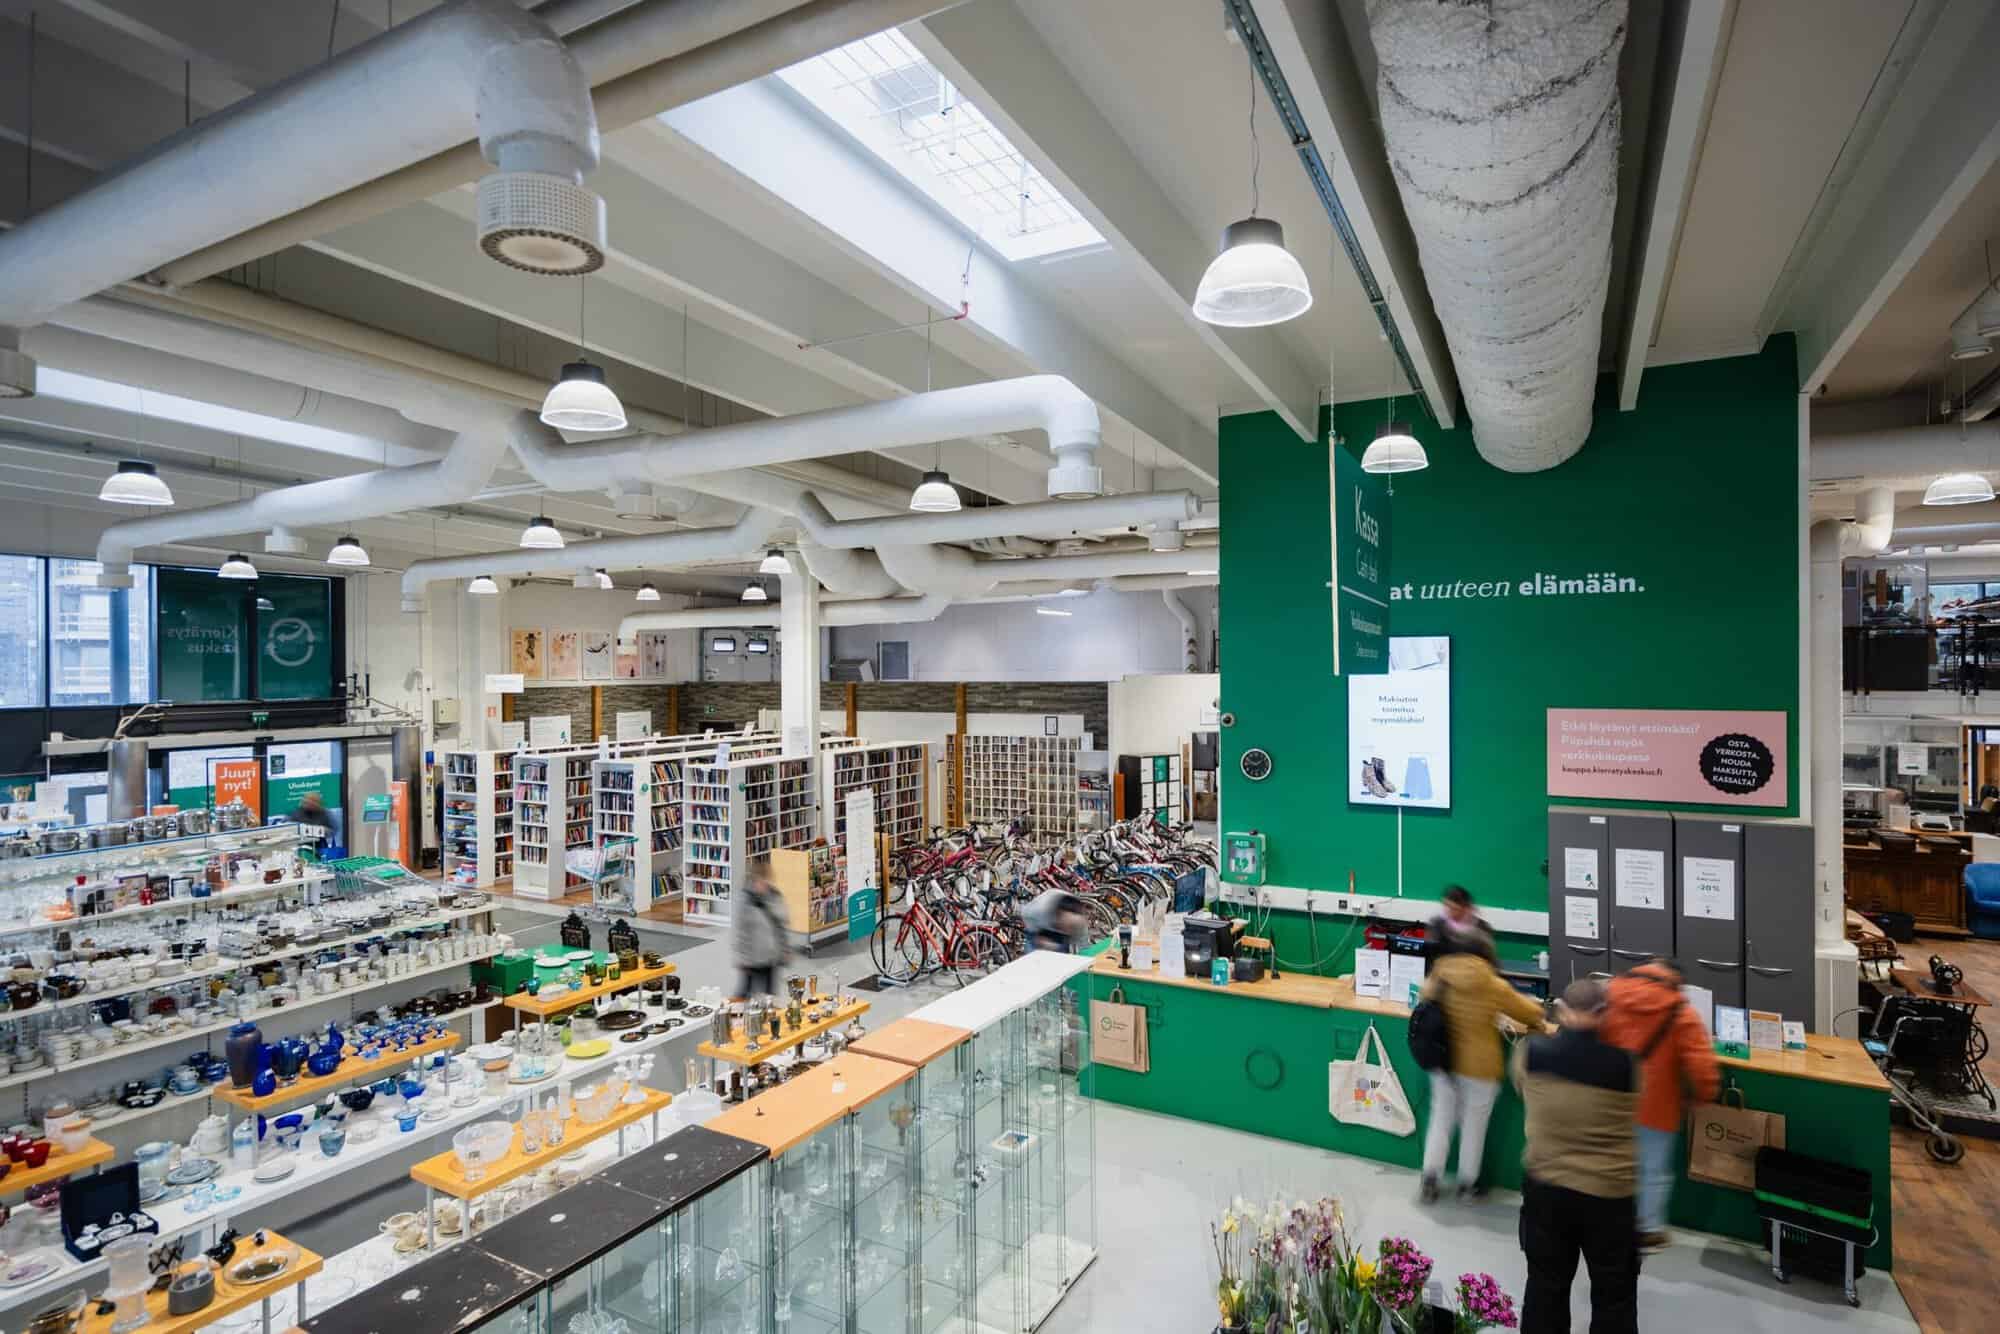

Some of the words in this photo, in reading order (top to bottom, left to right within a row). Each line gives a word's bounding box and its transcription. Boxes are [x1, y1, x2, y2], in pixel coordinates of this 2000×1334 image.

[1355, 485, 1379, 547] Kassa
[1420, 579, 1511, 600] uuteen
[1519, 572, 1645, 596] elämään.
[1728, 740, 1750, 748] OSTA
[1721, 758, 1752, 768] NOUDA
[219, 766, 257, 779] Juuri
[1713, 766, 1758, 778] MAKSUTTA
[224, 778, 252, 793] nyt!
[1712, 775, 1756, 786] KASSALTA!
